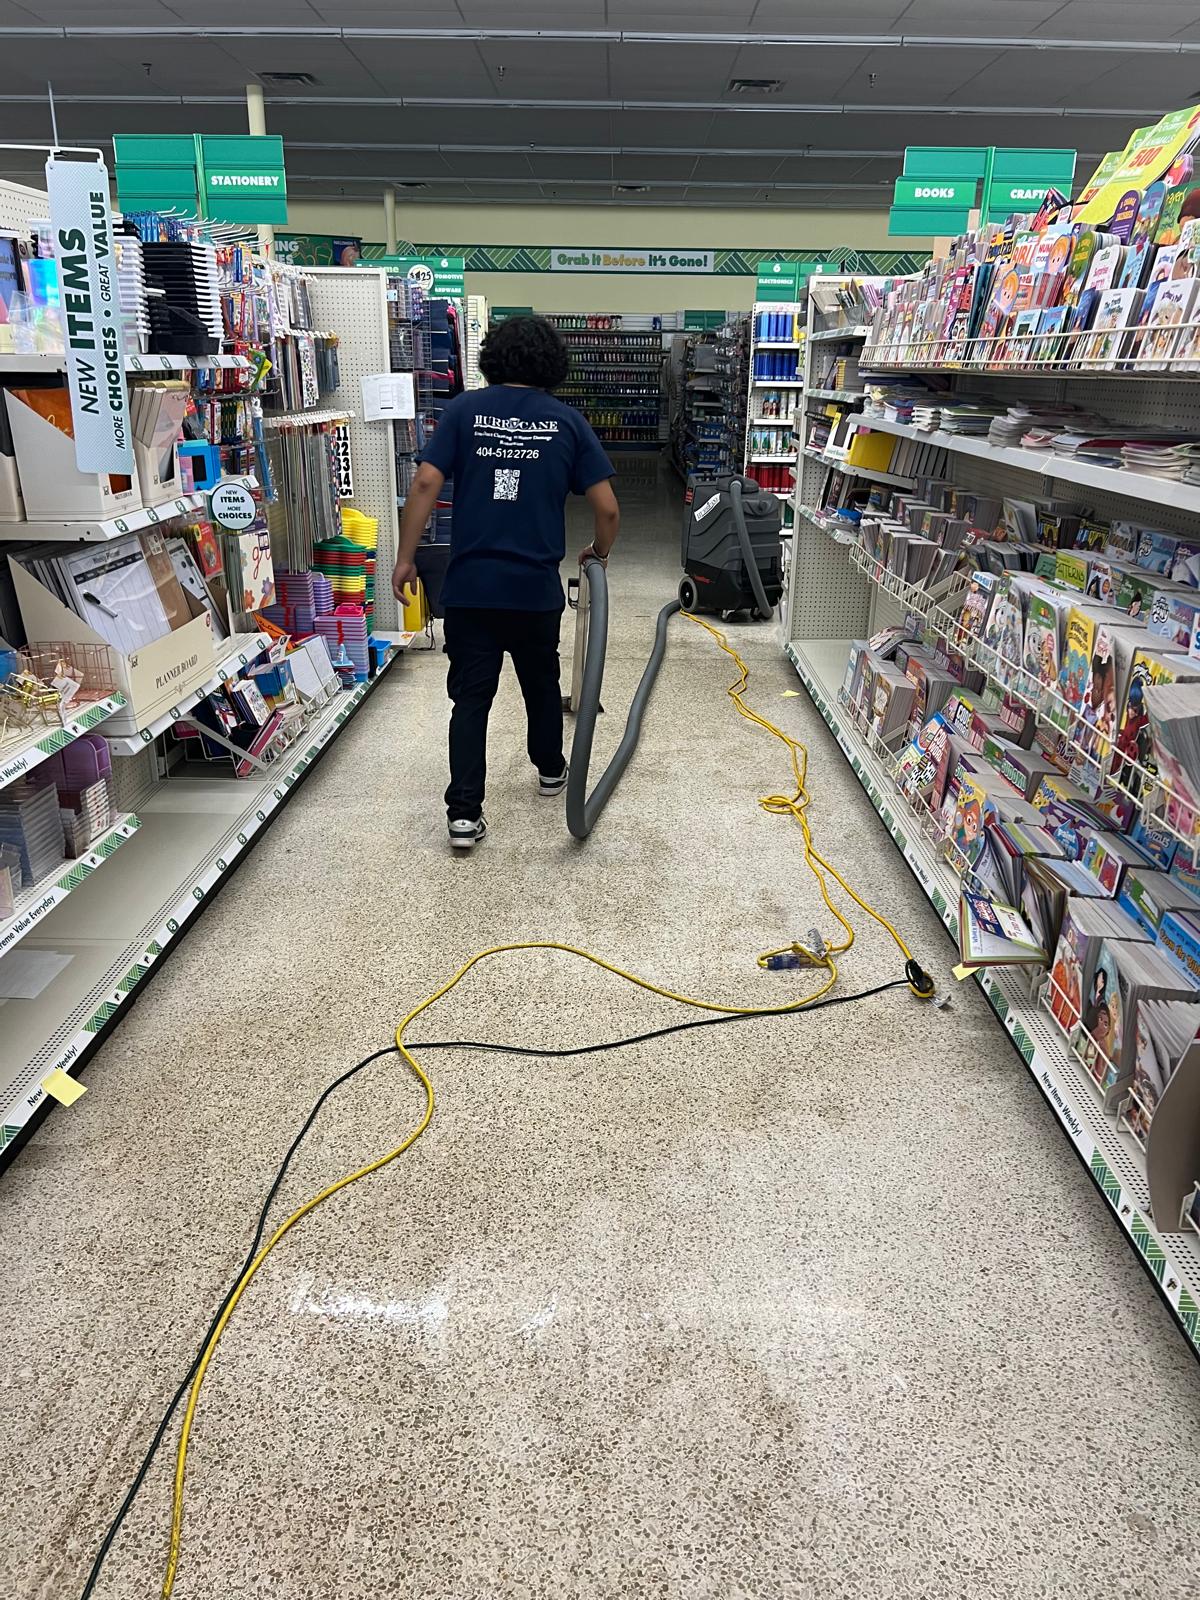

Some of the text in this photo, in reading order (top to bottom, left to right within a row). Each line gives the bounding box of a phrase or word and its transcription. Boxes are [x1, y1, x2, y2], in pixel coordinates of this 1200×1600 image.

[1128, 146, 1164, 169] 500
[210, 175, 280, 187] STATIONERY
[914, 187, 956, 199] BOOKS
[440, 258, 449, 268] 6
[557, 253, 590, 266] Grab
[603, 254, 646, 267] Before
[669, 255, 708, 267] Gone!
[773, 263, 782, 273] 6
[815, 264, 823, 273] 5
[59, 228, 100, 415] NEW ITEMS
[90, 191, 126, 450] MORE CHOICES GREAT VALUE
[155, 654, 198, 689] PLANNER BOARD
[2, 757, 29, 778] Weekly!
[12, 917, 31, 934] Value
[28, 894, 56, 920] Everyday
[27, 1045, 78, 1107] New Weekly!
[1041, 1071, 1083, 1137] New Items Weekly!
